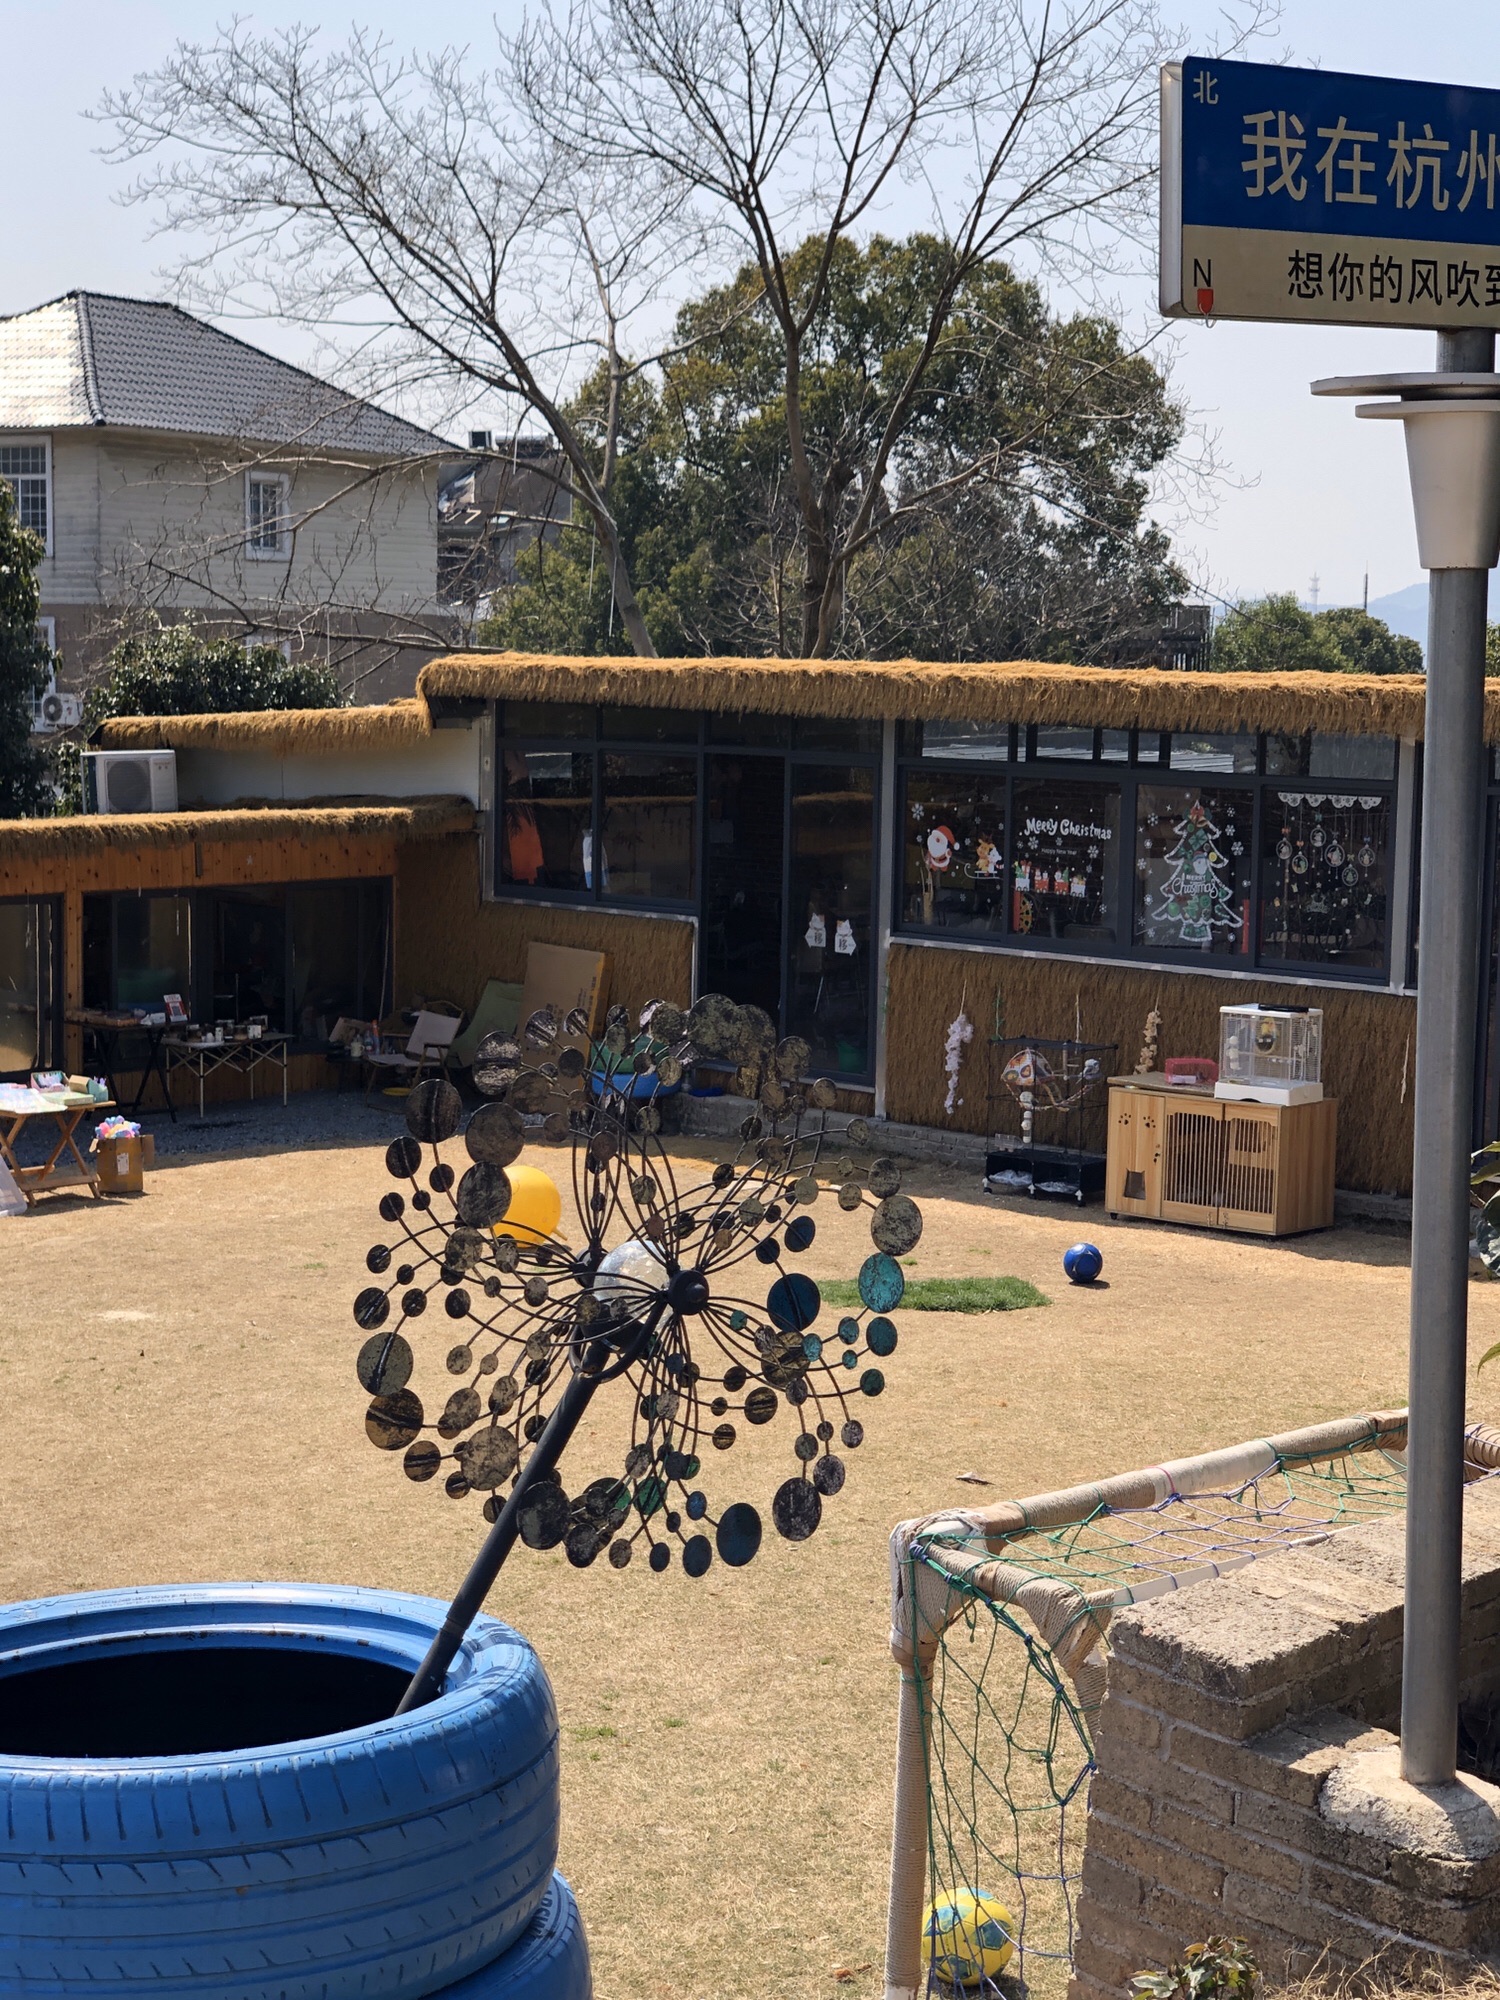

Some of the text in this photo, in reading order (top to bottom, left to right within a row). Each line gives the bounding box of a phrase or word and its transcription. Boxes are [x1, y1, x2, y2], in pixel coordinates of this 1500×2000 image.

[1193, 70, 1219, 105] 北
[1241, 110, 1500, 212] 我在杭州
[1193, 258, 1212, 288] N
